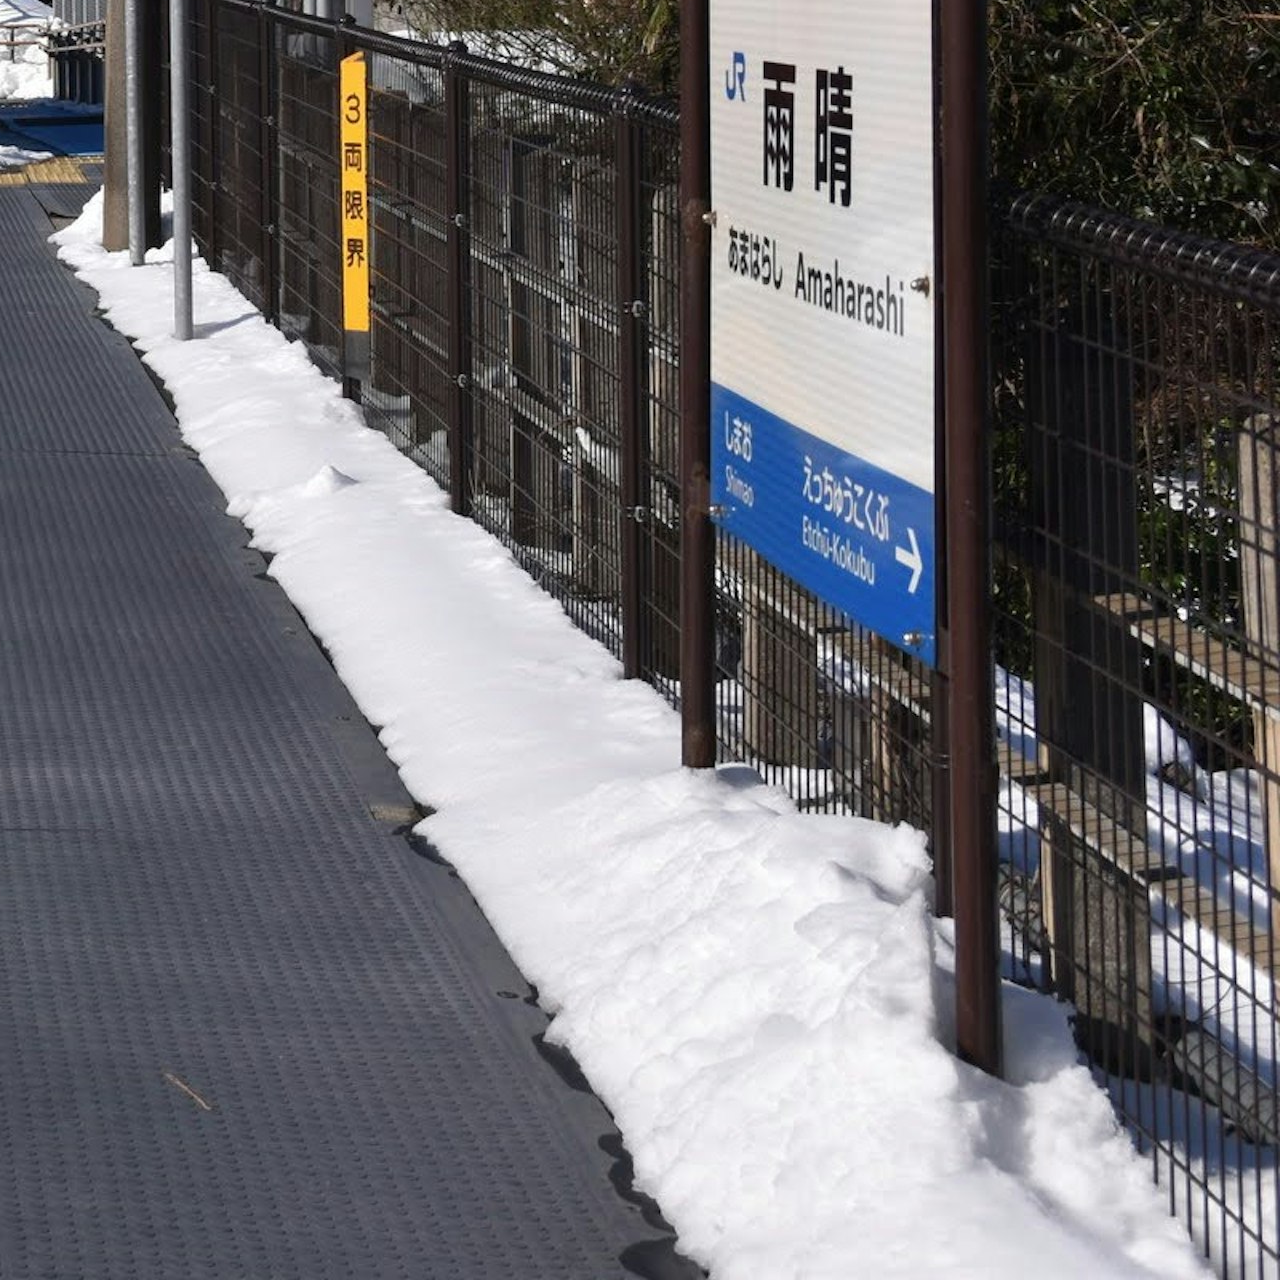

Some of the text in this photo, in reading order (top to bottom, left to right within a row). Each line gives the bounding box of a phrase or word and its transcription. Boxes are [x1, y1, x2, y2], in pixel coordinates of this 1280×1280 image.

[726, 51, 746, 102] JR
[763, 60, 853, 208] 雨晴
[344, 95, 364, 268] 3両限界
[728, 225, 904, 337] あまはらし Amaharashi
[725, 410, 890, 541] しまお えっちゅうこくぶ
[726, 465, 754, 508] Shimao
